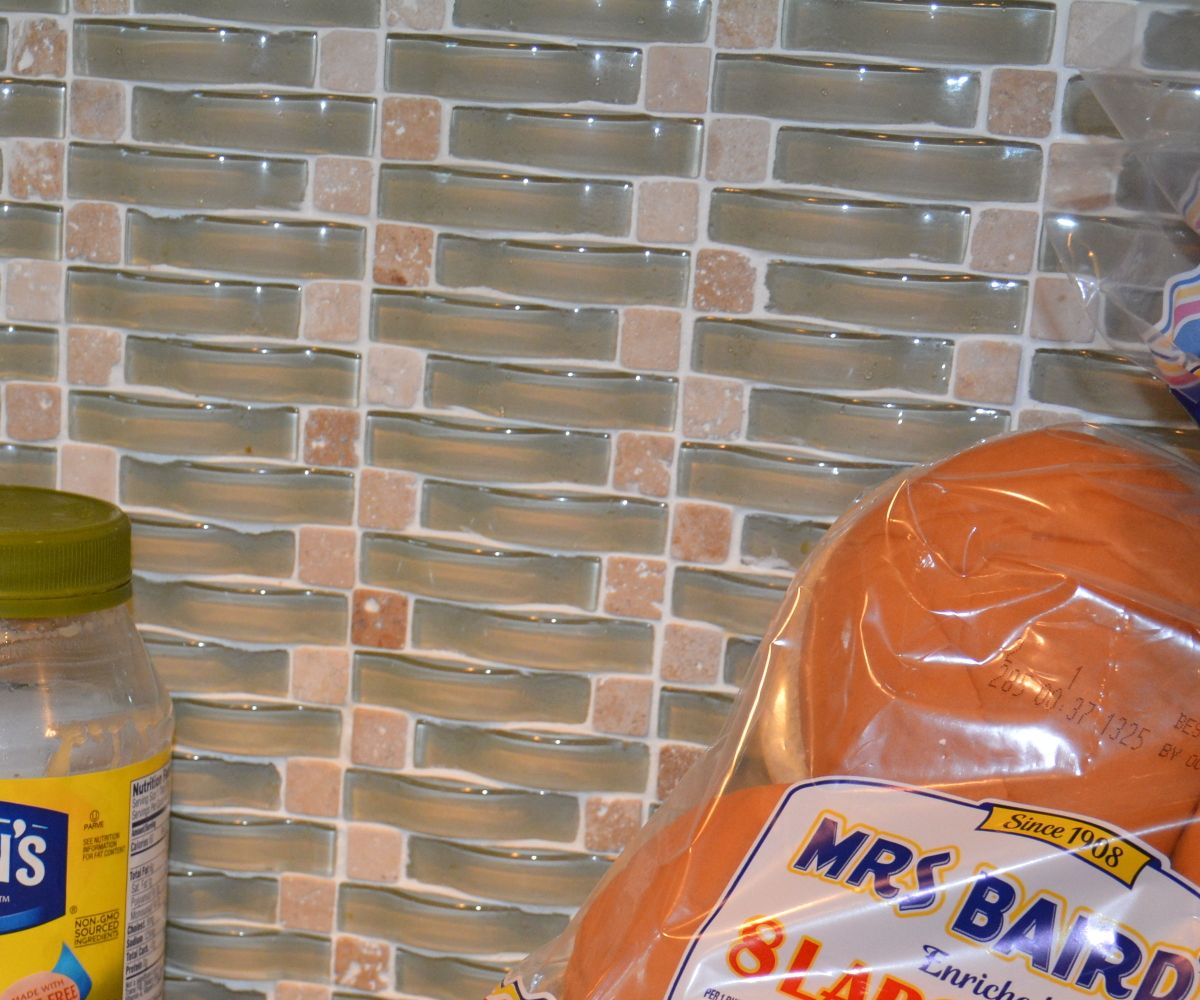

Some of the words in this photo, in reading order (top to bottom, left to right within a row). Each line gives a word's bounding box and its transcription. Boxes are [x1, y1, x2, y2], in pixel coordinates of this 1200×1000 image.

[1003, 813, 1065, 840] Since
[1067, 825, 1125, 869] 1908
[791, 814, 954, 914] MRS
[74, 920, 120, 939] SOURCED
[74, 931, 119, 946] INGREDIENTS
[729, 917, 784, 980] 8
[41, 978, 65, 994] WITH
[703, 988, 719, 1000] PER
